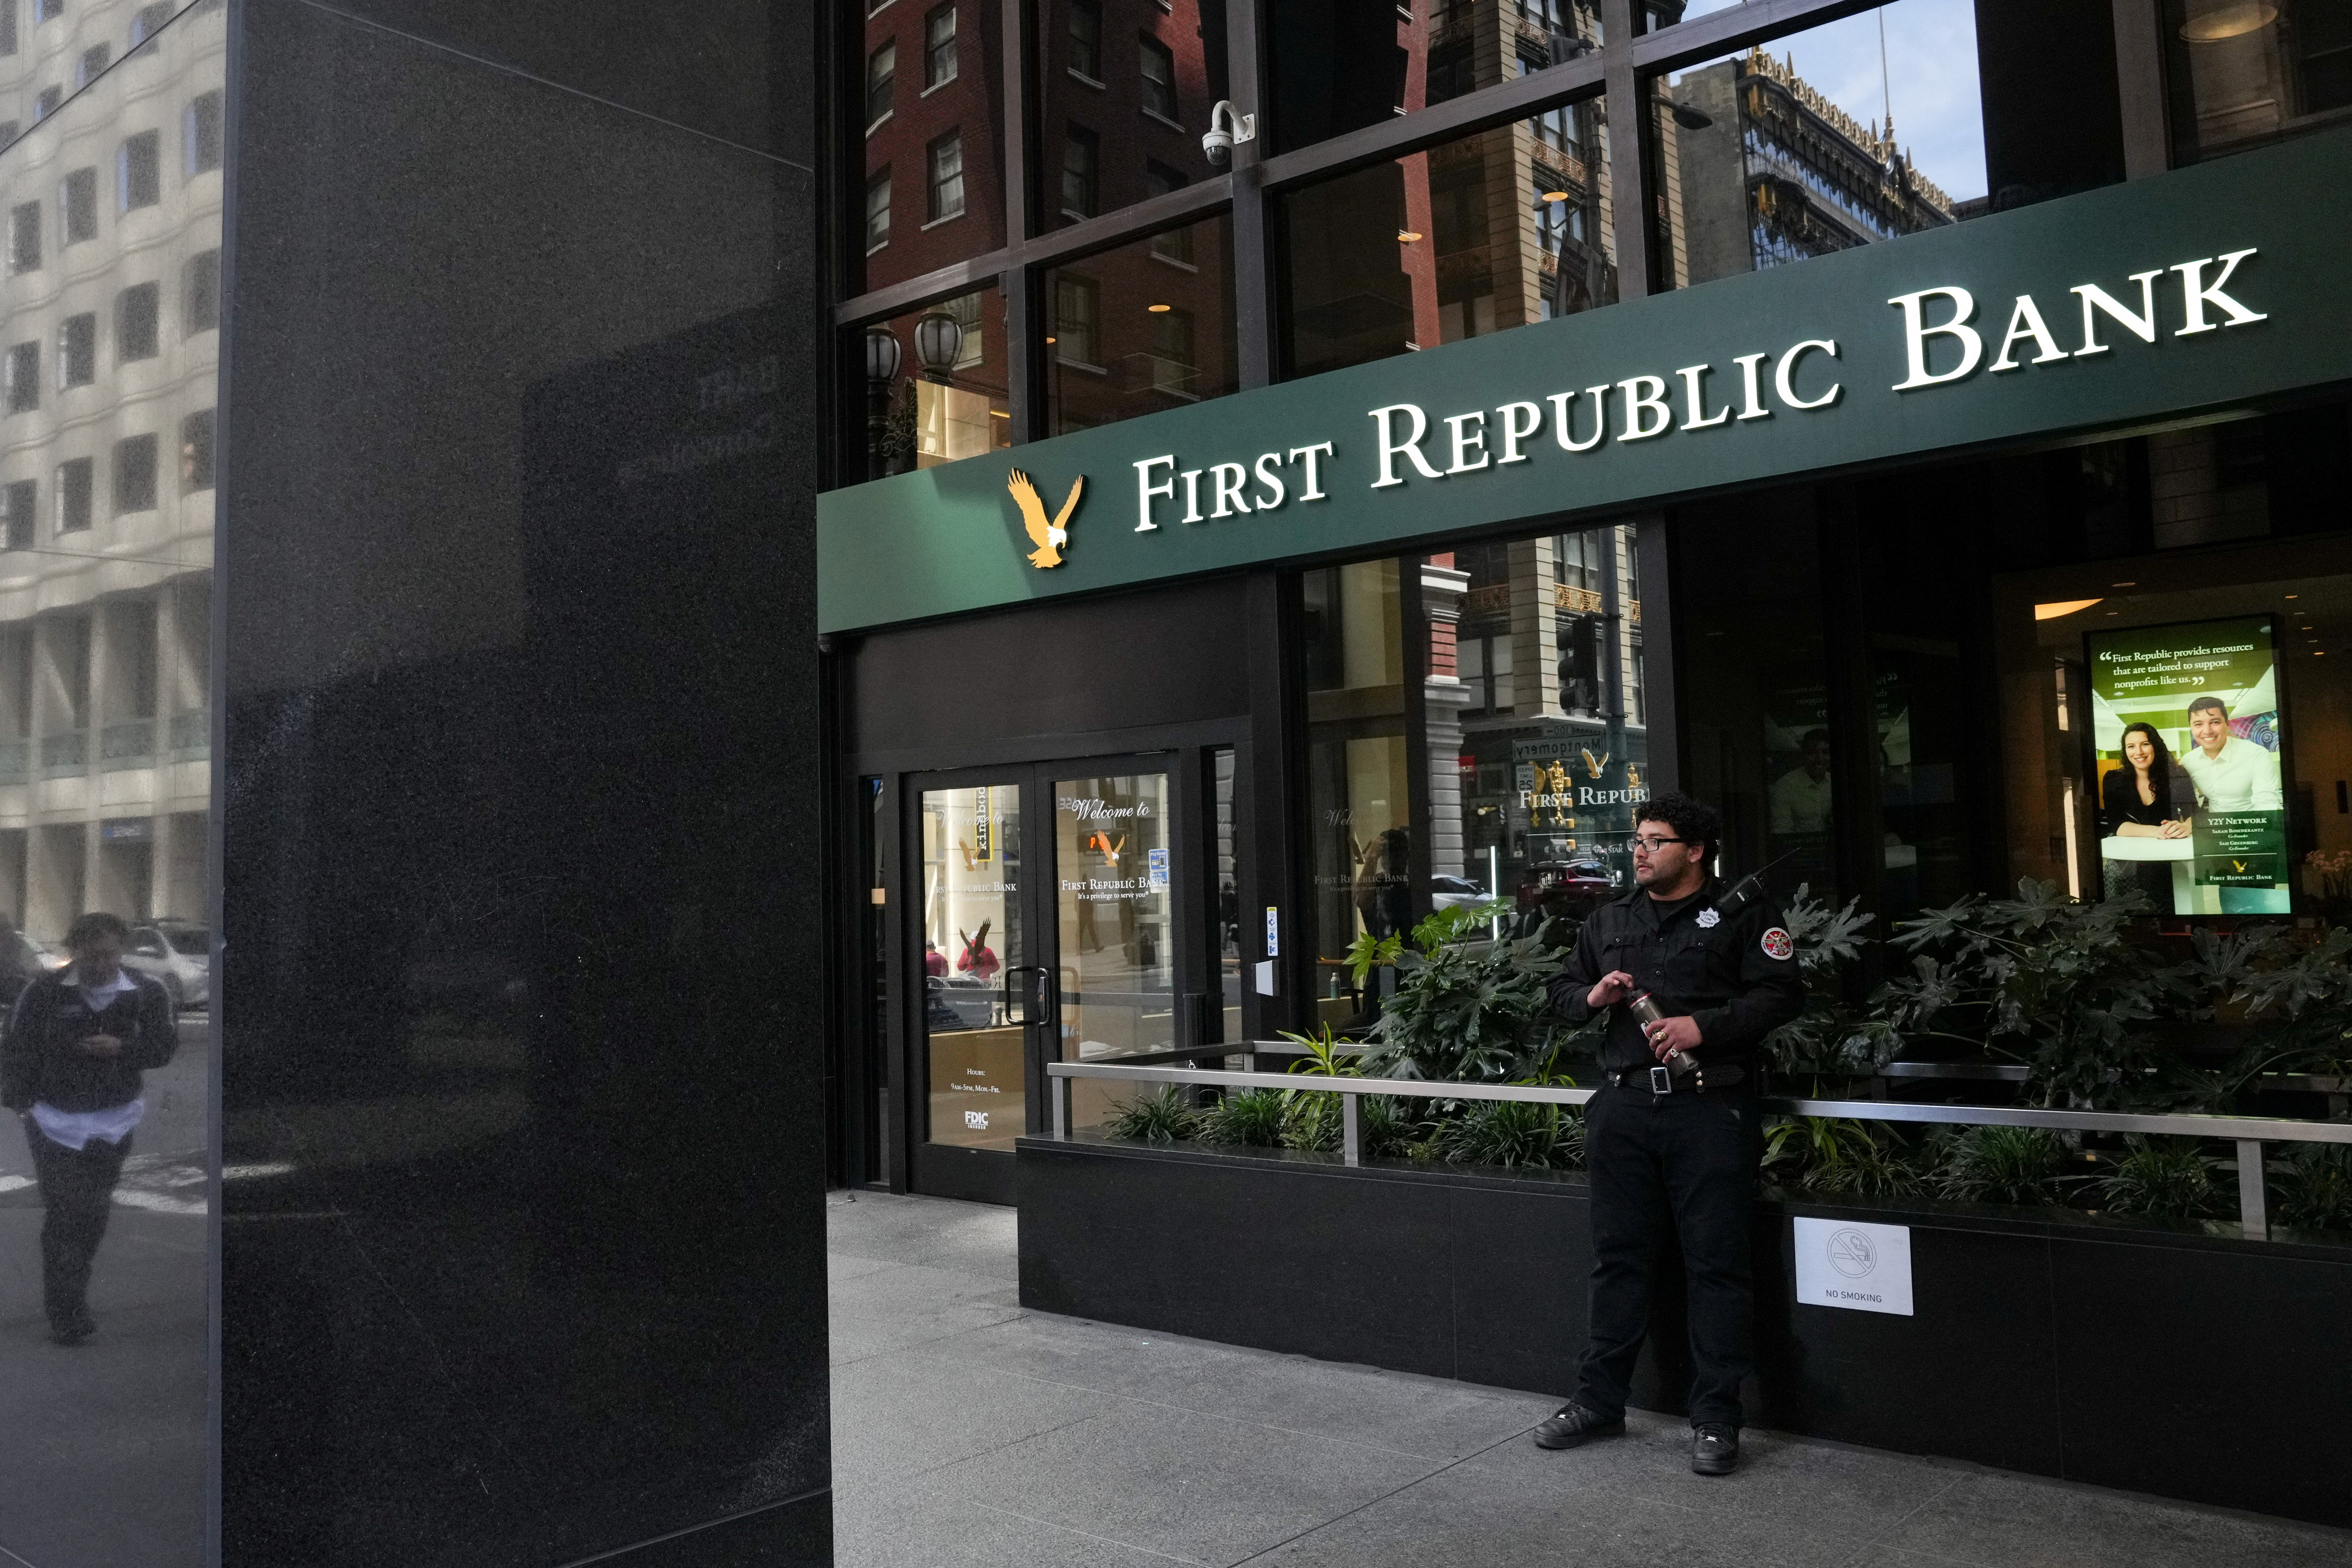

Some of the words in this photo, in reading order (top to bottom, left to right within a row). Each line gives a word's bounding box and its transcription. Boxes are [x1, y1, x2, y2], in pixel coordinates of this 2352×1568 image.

[1133, 441, 1333, 532] FIRST
[1367, 339, 1840, 488] REPUBLIC
[1887, 248, 2268, 391] BANK
[2134, 649, 2172, 662] Republic
[2174, 646, 2210, 659] provides
[2212, 644, 2254, 654] resources
[2114, 667, 2131, 675] that
[2148, 661, 2181, 673] tailored
[2194, 659, 2229, 670] support
[2114, 677, 2158, 690] nonprofits
[2160, 675, 2177, 685] like
[1519, 791, 1572, 808] FIRST
[1579, 786, 1650, 806] REPUB
[937, 809, 989, 828] Wlcome
[993, 810, 1004, 824] to
[976, 786, 987, 850] kindbod
[1072, 799, 1134, 821] Welcome
[1137, 801, 1150, 816] to
[993, 881, 1017, 891] BANK
[1062, 880, 1086, 890] FIRST
[1090, 879, 1135, 890] REPUBLIC
[1138, 877, 1165, 888] BANK
[965, 1111, 988, 1124] FDIC
[1826, 1290, 1838, 1298] NO
[1841, 1291, 1882, 1303] SMOKING
